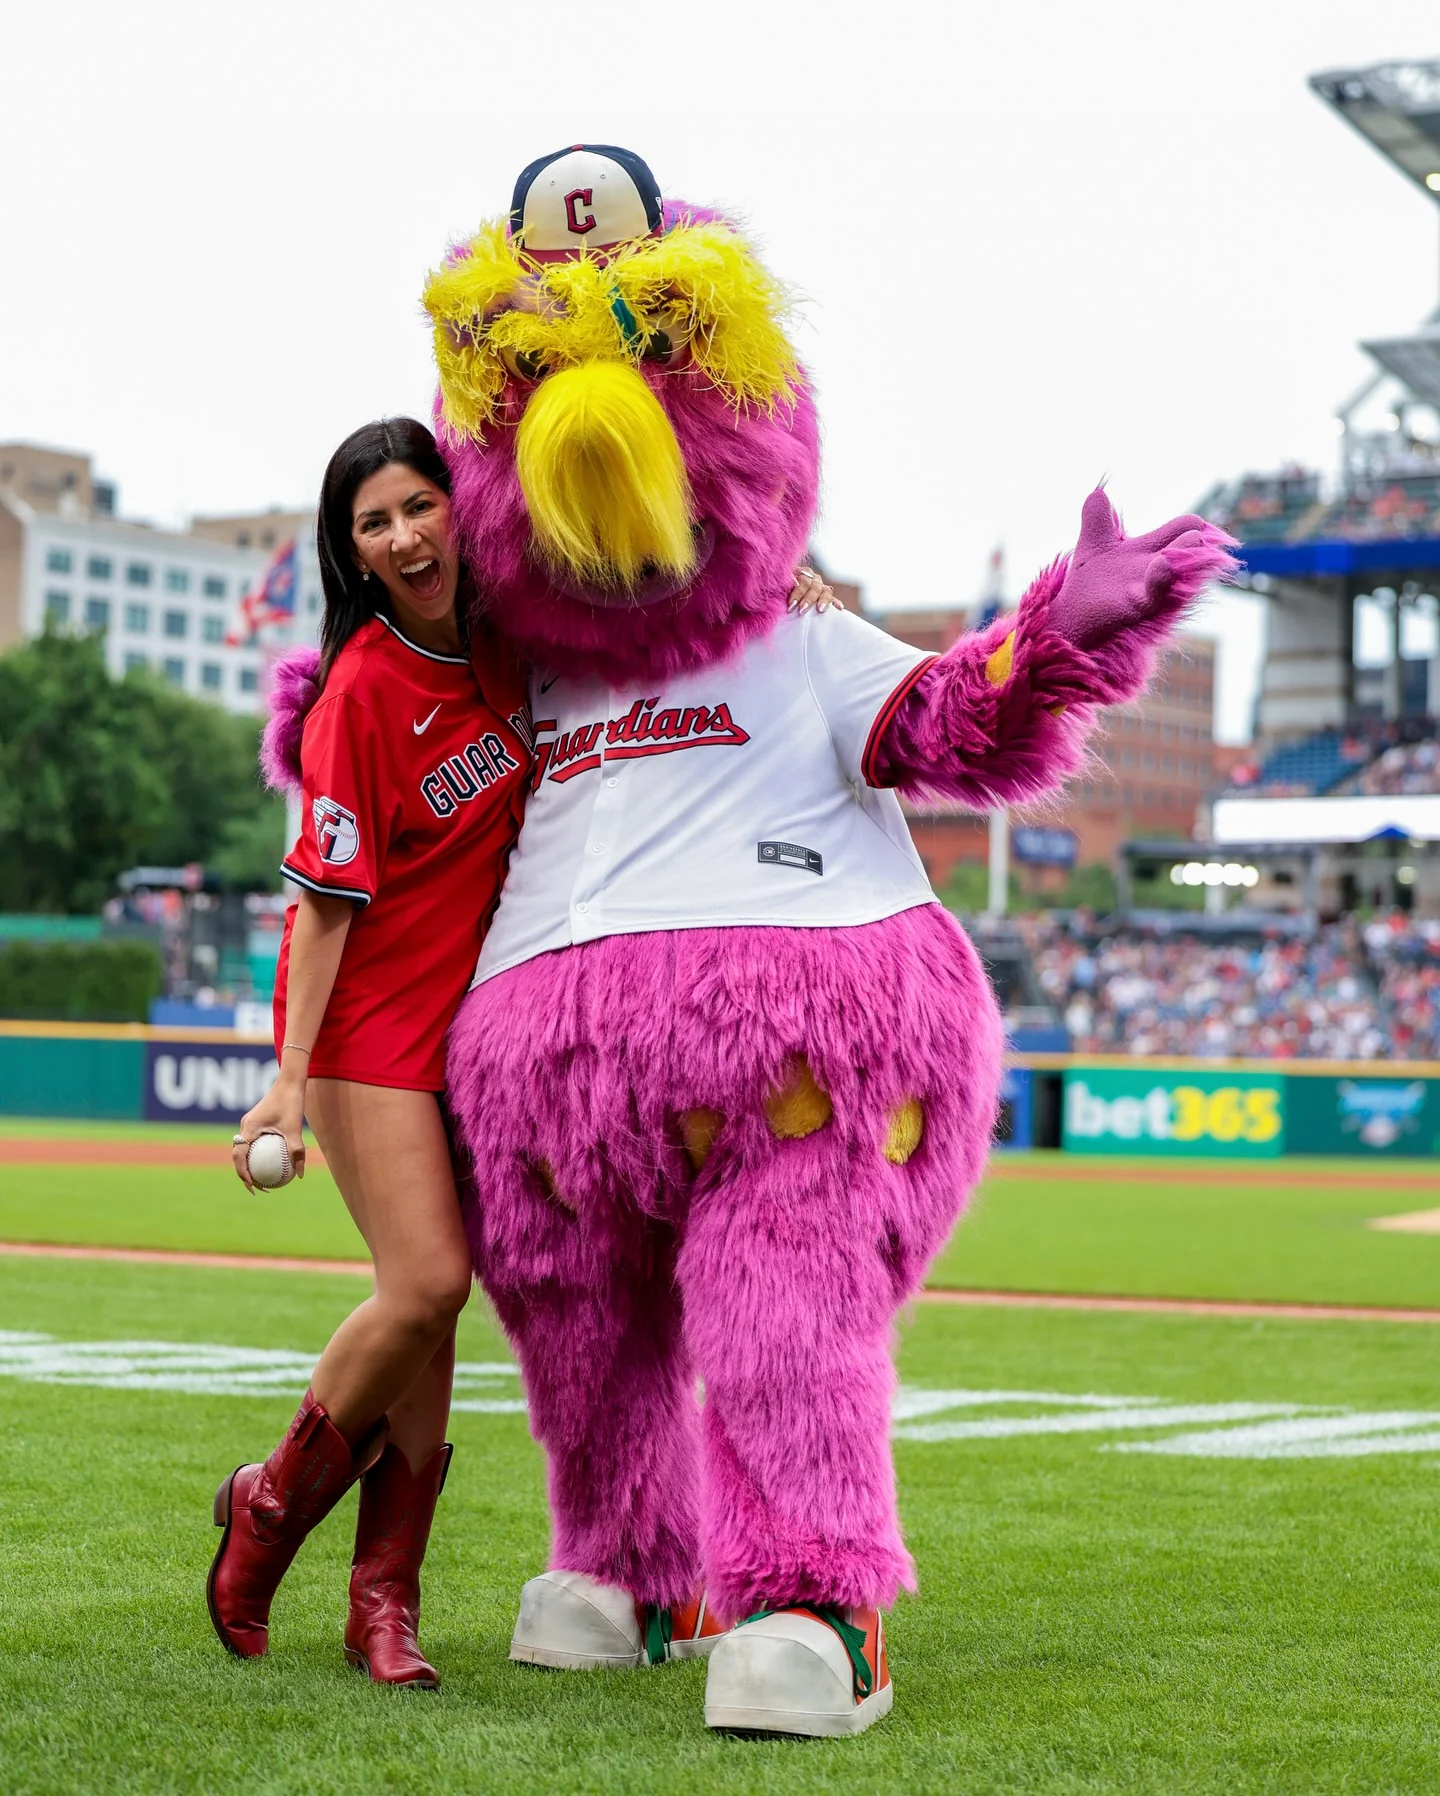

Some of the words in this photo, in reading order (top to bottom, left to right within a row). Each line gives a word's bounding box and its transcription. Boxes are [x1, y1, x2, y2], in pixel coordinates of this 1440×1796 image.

[564, 188, 597, 235] C
[533, 697, 751, 796] Guardians
[1066, 1081, 1283, 1143] bet365
